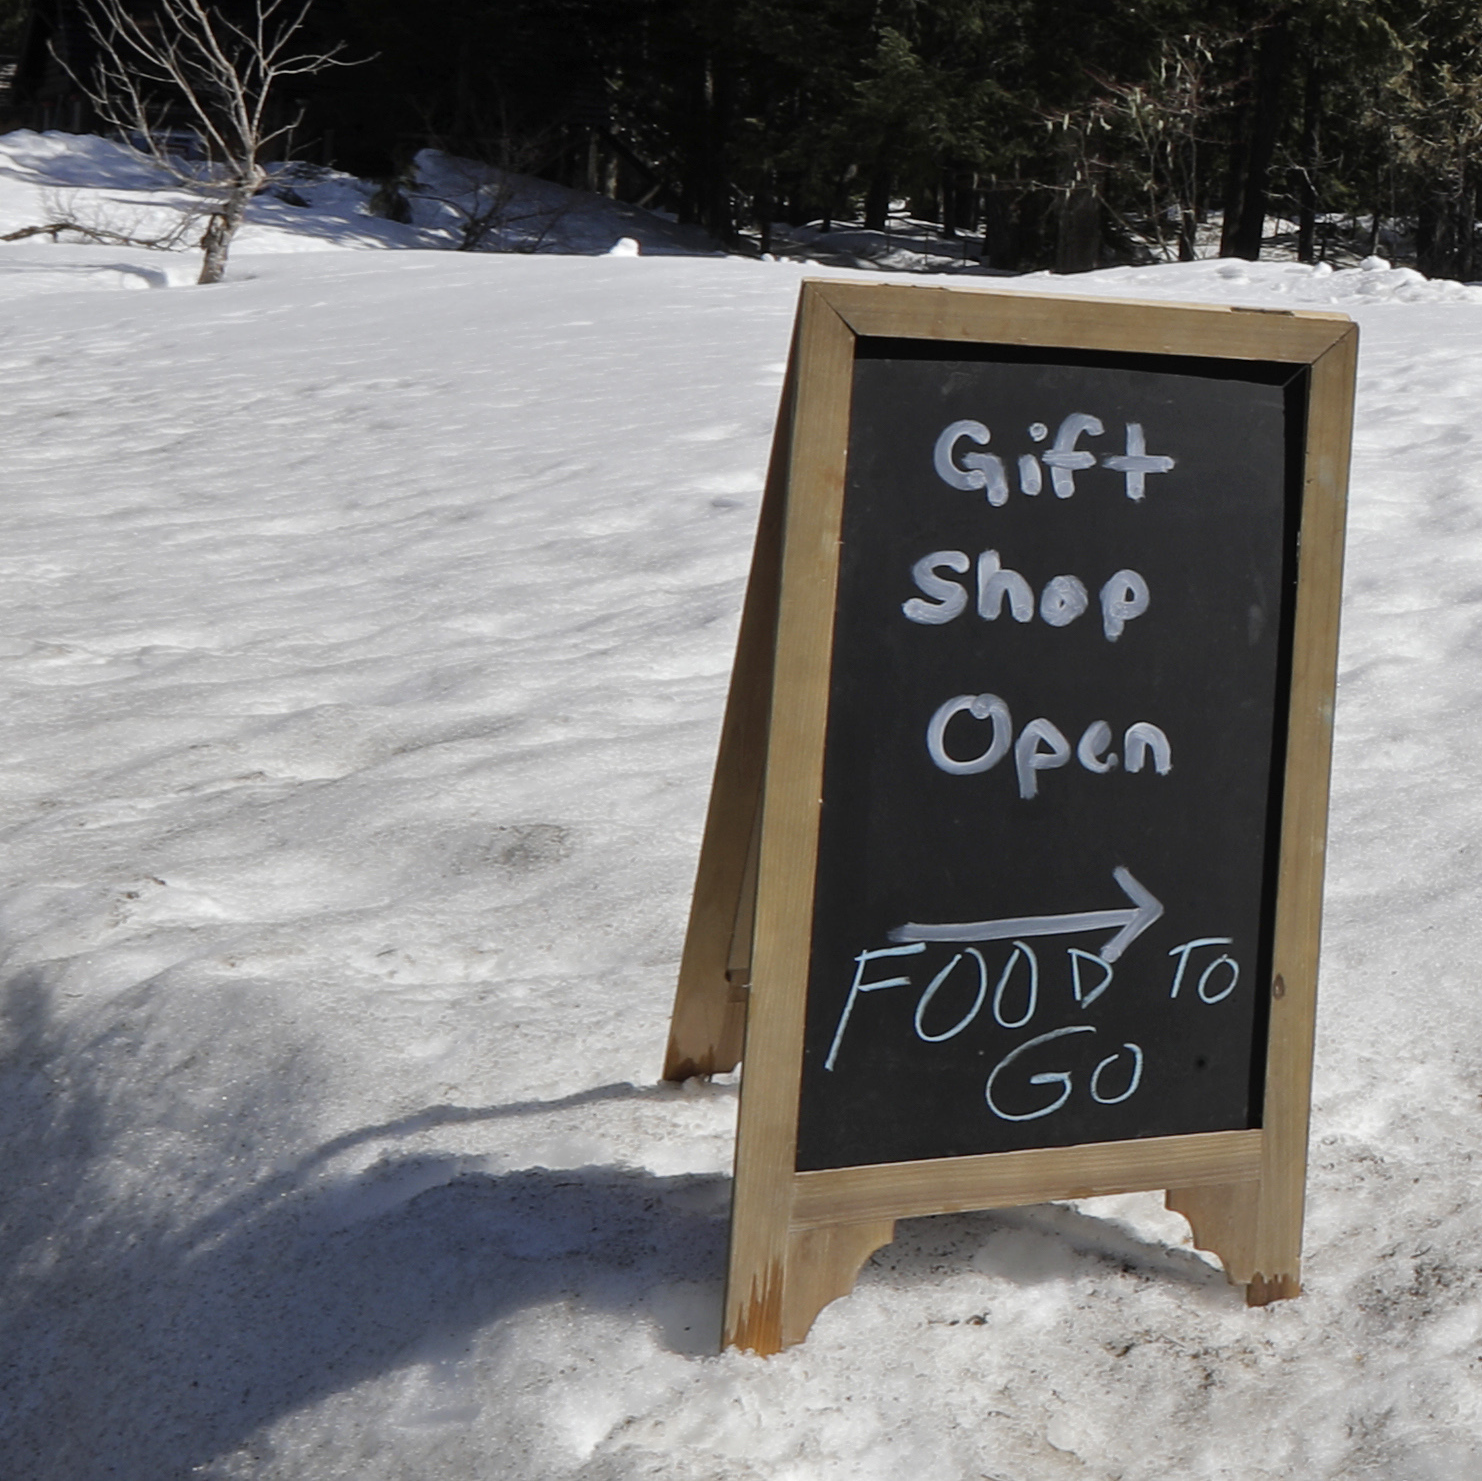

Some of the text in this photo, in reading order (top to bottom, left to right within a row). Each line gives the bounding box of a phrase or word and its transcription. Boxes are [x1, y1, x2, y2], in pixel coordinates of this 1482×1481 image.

[934, 413, 1175, 507] Gift
[902, 549, 1150, 642] Shop
[927, 693, 1172, 799] Open
[825, 940, 1113, 1070] FOOD
